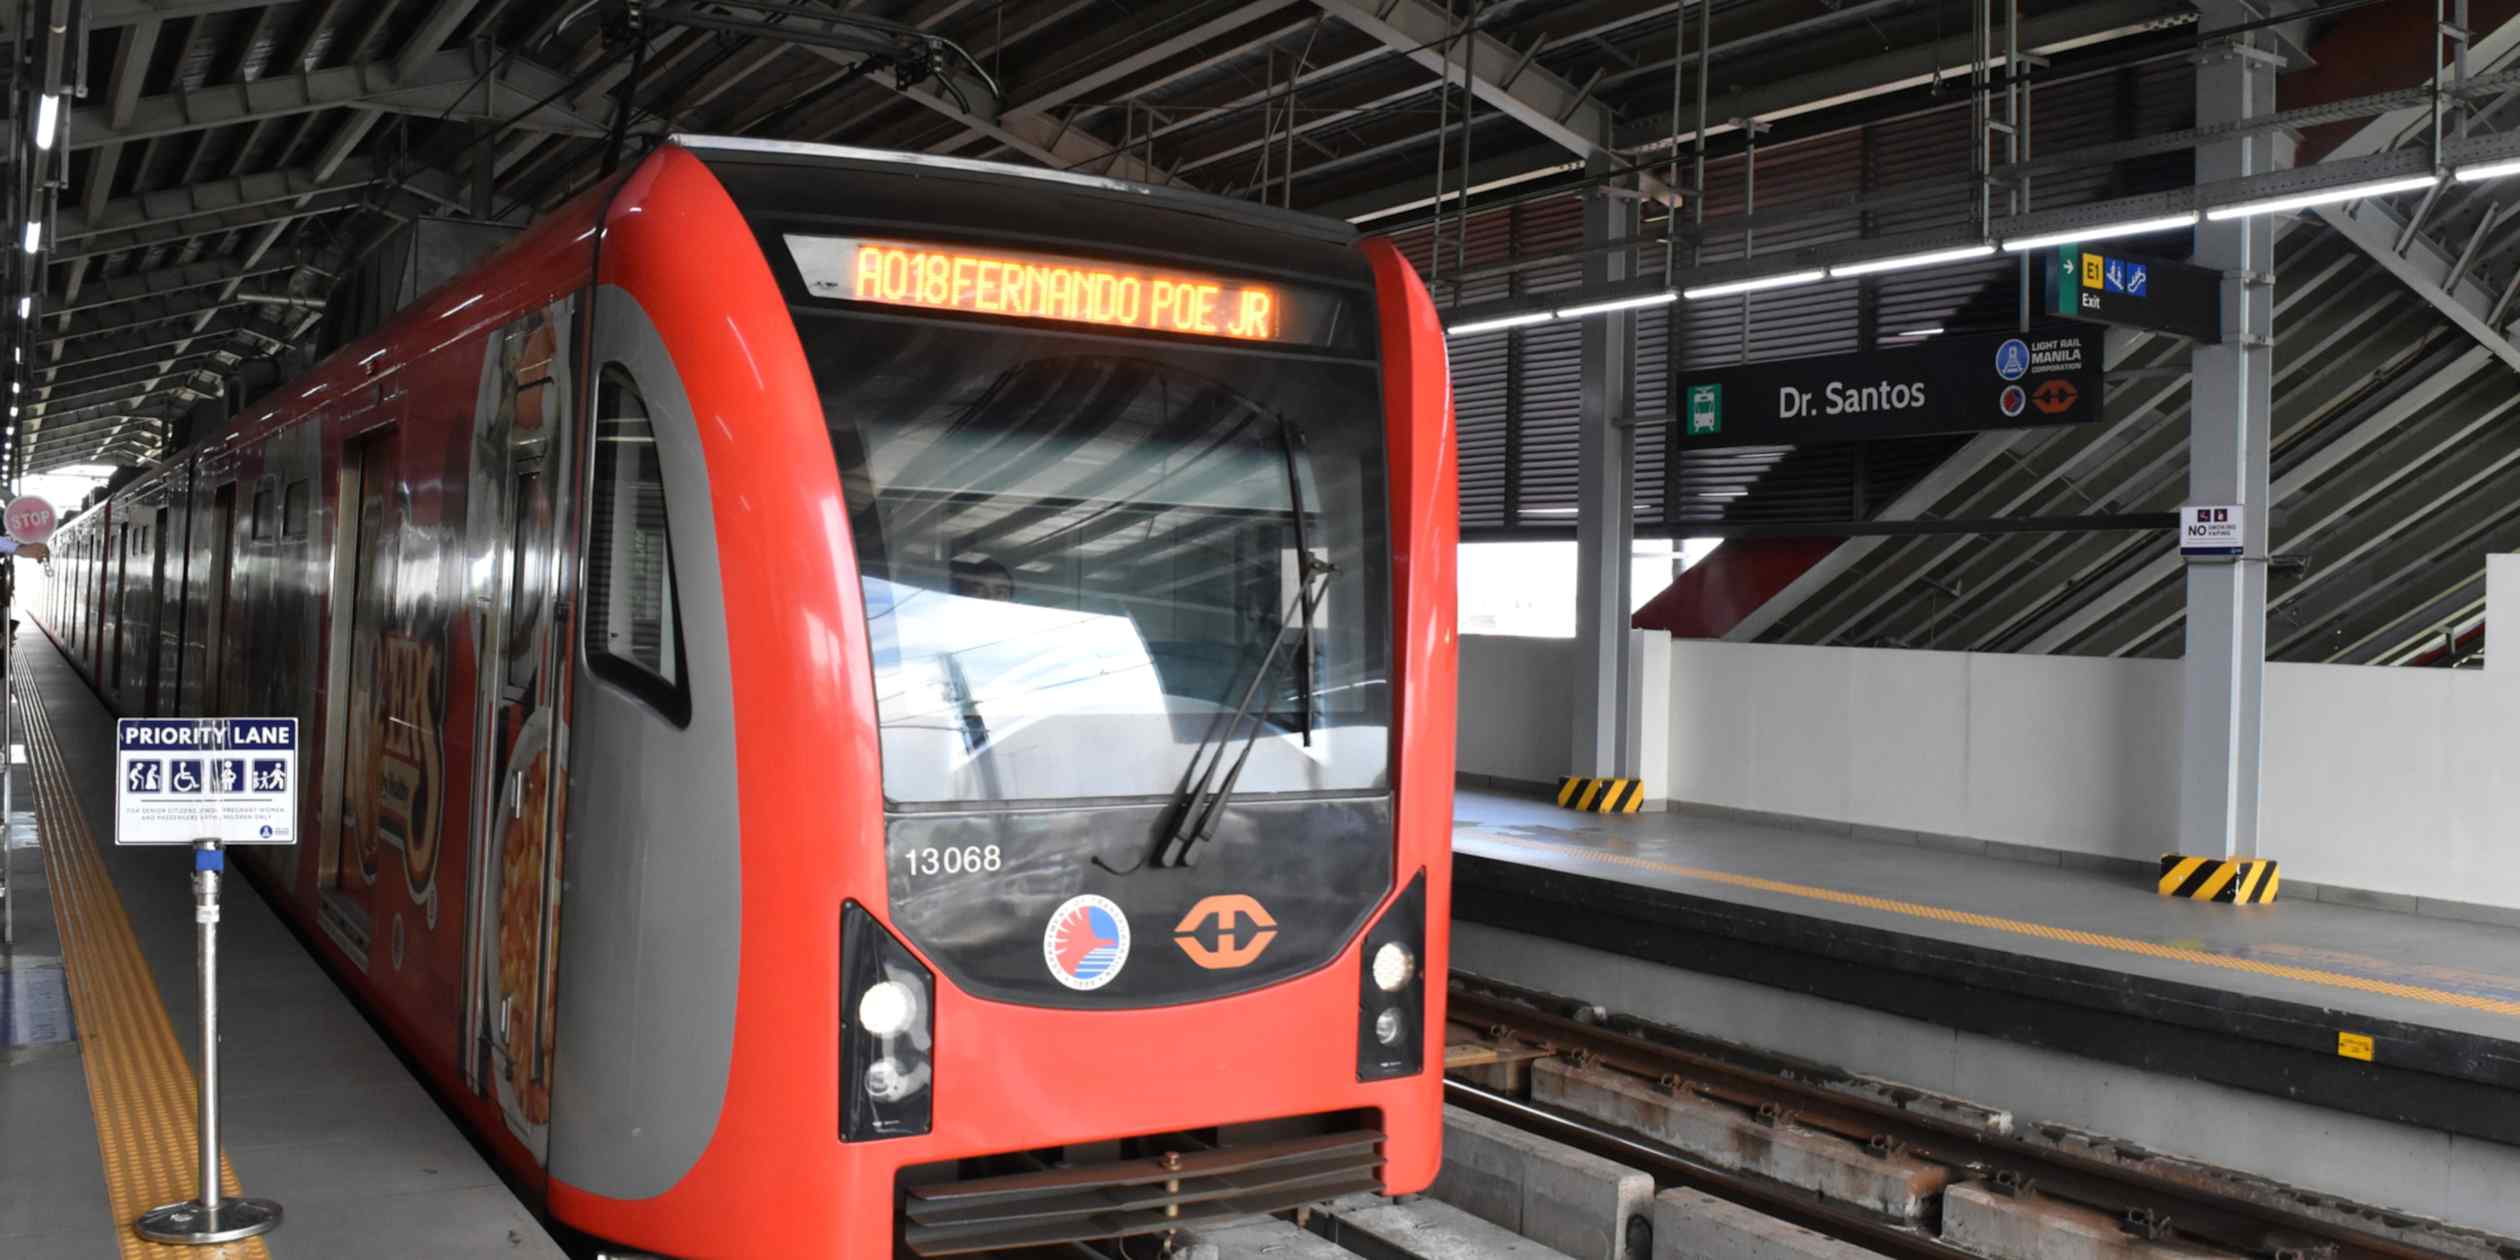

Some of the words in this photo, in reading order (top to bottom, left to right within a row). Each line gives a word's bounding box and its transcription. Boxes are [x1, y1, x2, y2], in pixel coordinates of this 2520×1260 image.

[2087, 261, 2099, 281] E1
[1149, 279, 1218, 334] POE
[1228, 287, 1271, 338] JR
[2082, 293, 2101, 309] Exit
[2031, 340, 2058, 351] LIGHT
[2060, 338, 2081, 348] RAIL
[2031, 349, 2081, 364] MANILA
[1779, 387, 1817, 418] Dr.
[1825, 380, 1926, 415] Santos
[11, 511, 49, 529] STOP
[2188, 524, 2207, 536] NO
[125, 727, 227, 745] PRIORITY
[234, 727, 290, 745] LANE
[905, 845, 1001, 876] 13068
